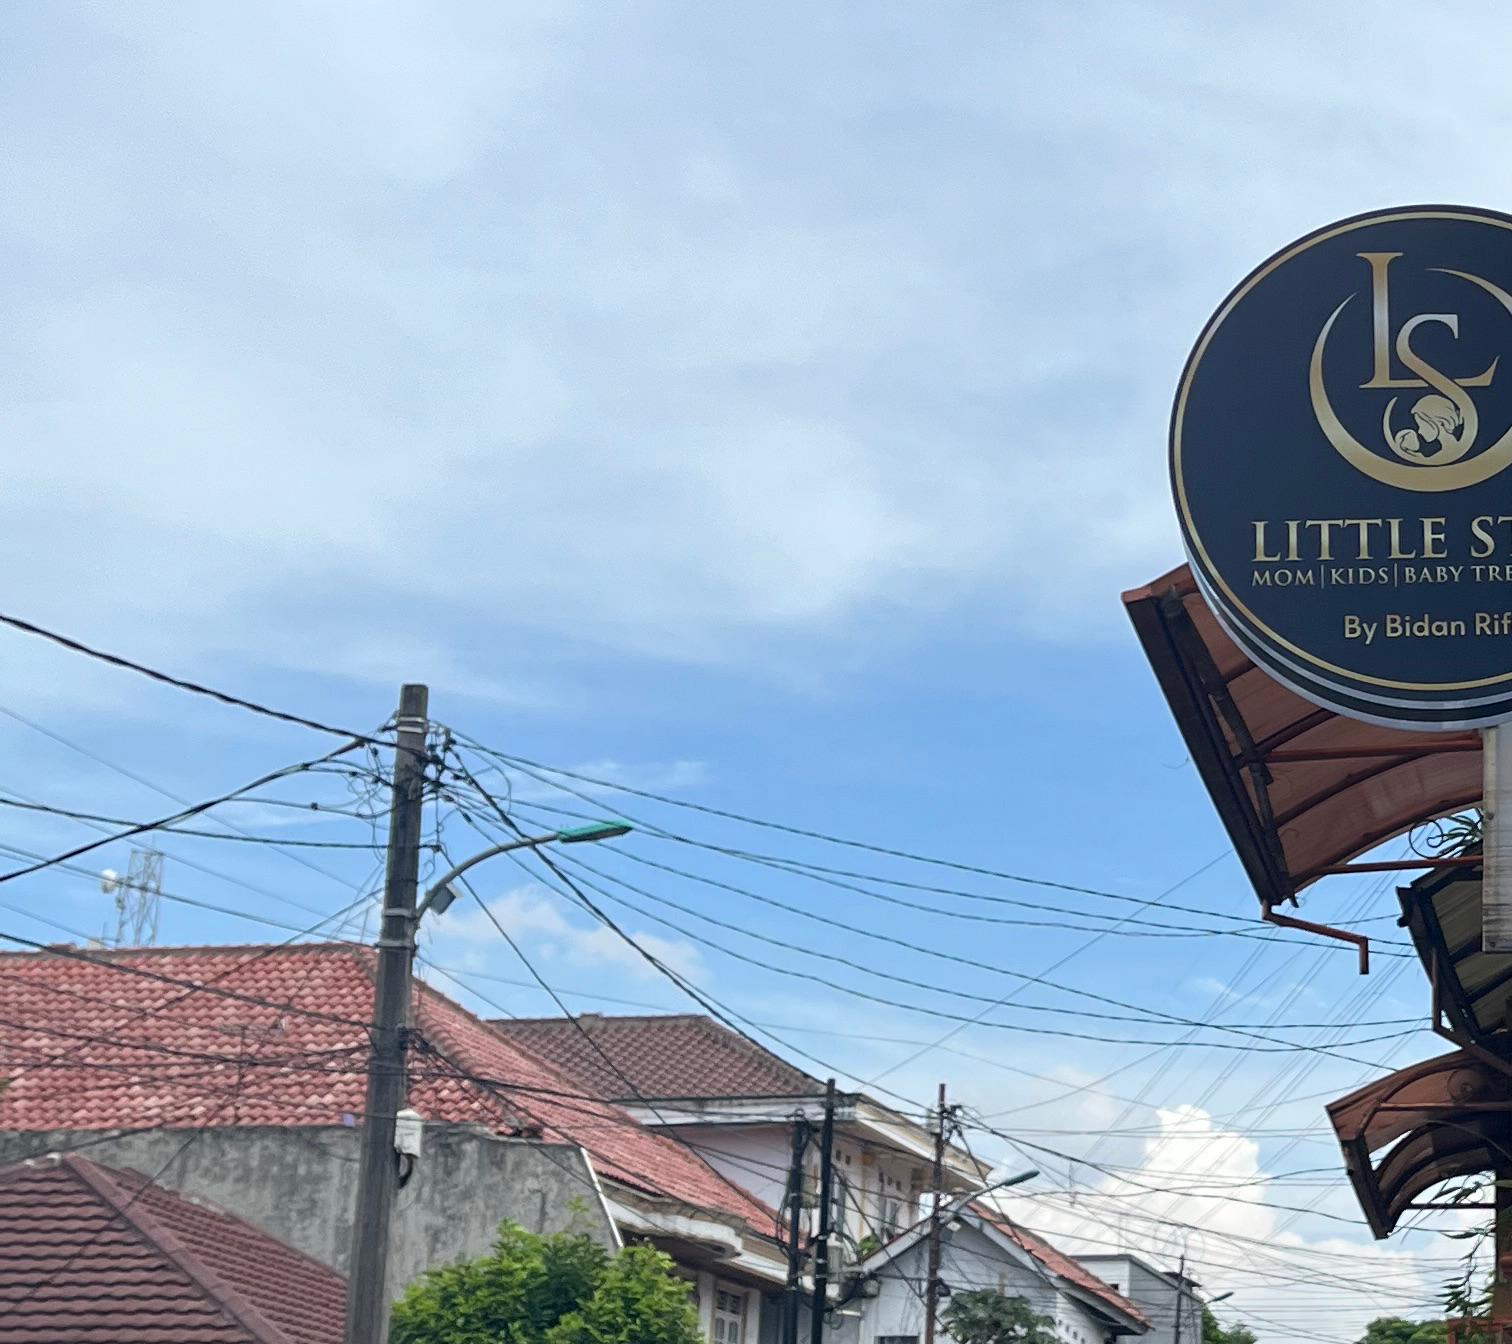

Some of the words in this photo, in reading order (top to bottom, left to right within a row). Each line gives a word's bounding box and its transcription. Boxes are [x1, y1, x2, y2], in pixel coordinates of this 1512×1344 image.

[1251, 518, 1448, 562] LITTLE
[1252, 569, 1314, 586] MOM
[1331, 567, 1388, 585] KIDS
[1405, 566, 1463, 583] BABY
[1344, 615, 1377, 645] By
[1386, 614, 1466, 637] Bidan
